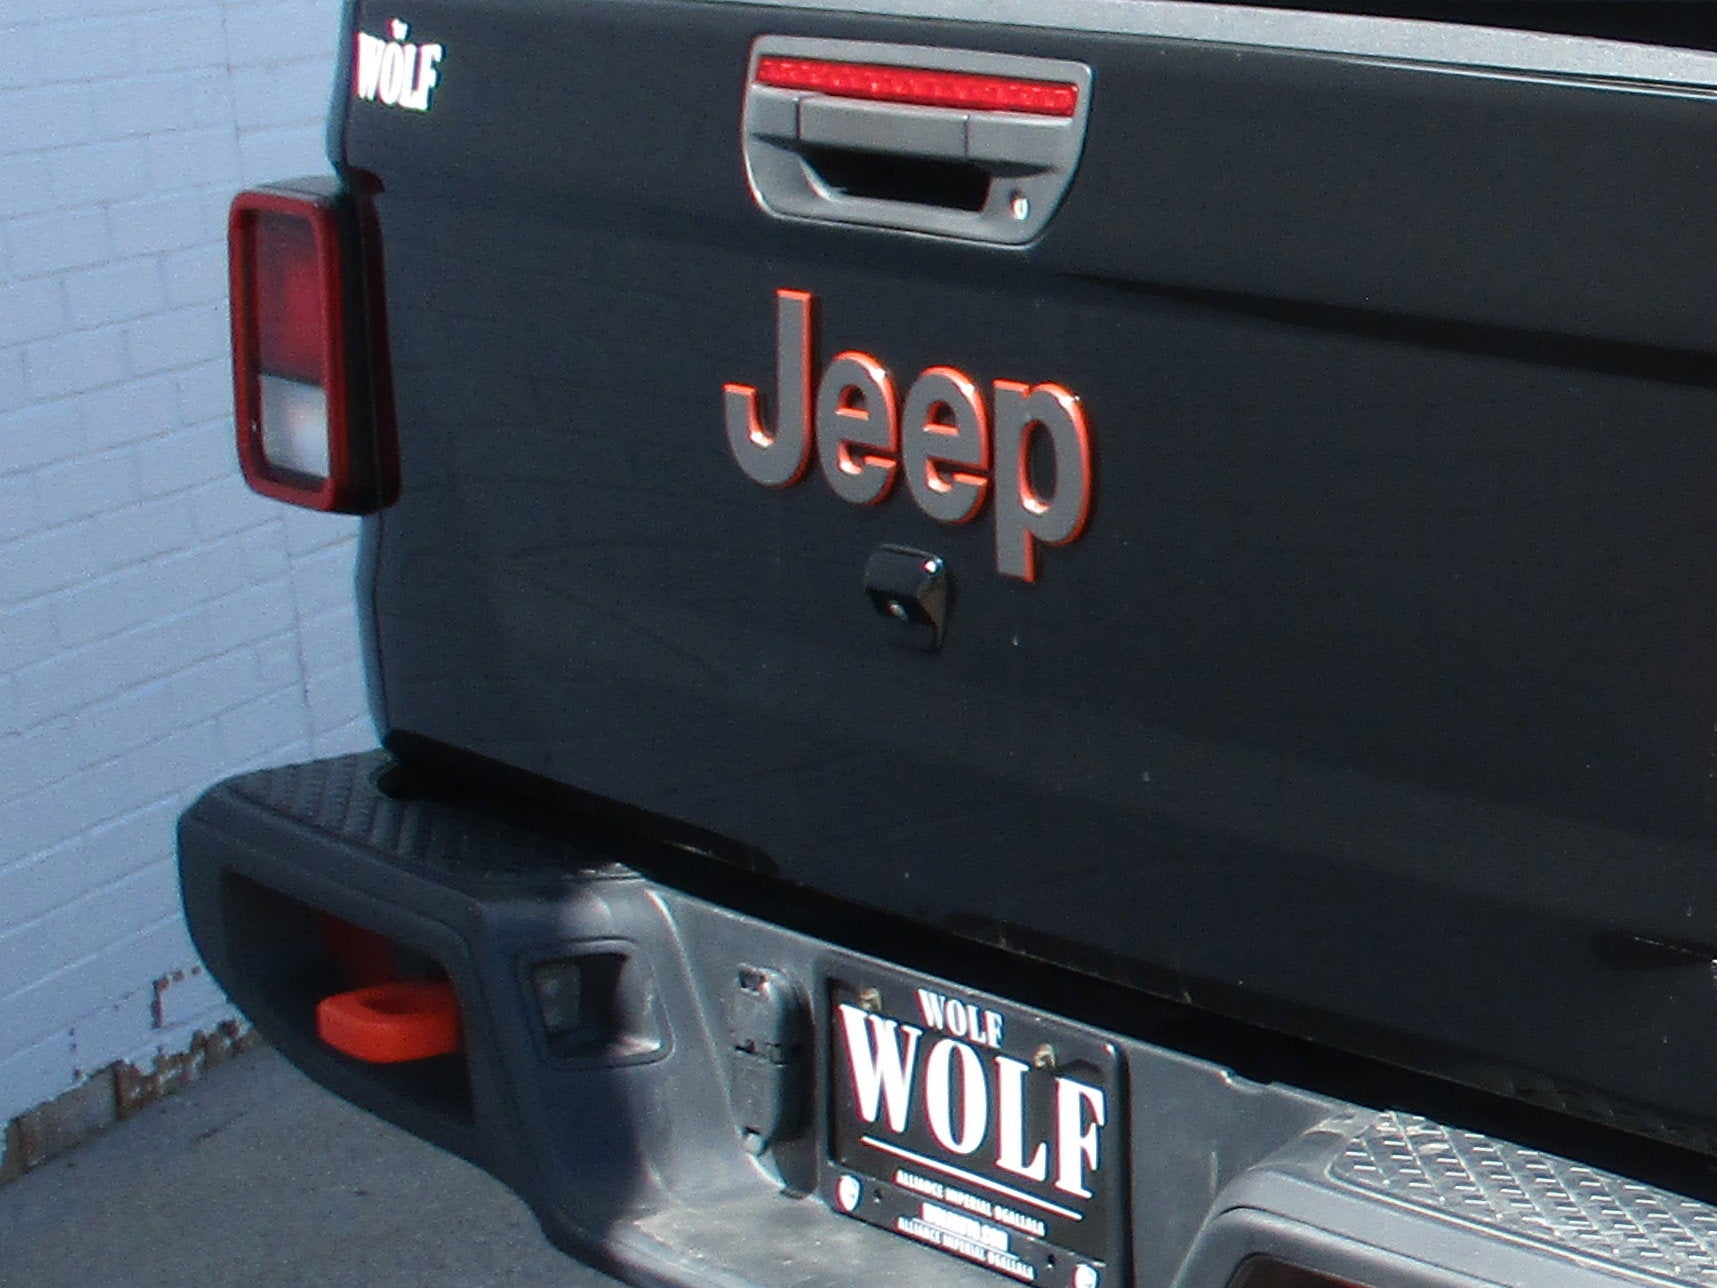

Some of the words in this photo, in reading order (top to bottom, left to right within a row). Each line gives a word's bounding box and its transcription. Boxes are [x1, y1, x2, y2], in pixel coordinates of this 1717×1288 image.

[355, 31, 444, 112] WOLF
[722, 288, 1092, 583] Jeep
[916, 988, 1004, 1049] WOLF
[837, 1002, 1106, 1200] WOLF
[944, 1187, 993, 1218] IMPERIAL
